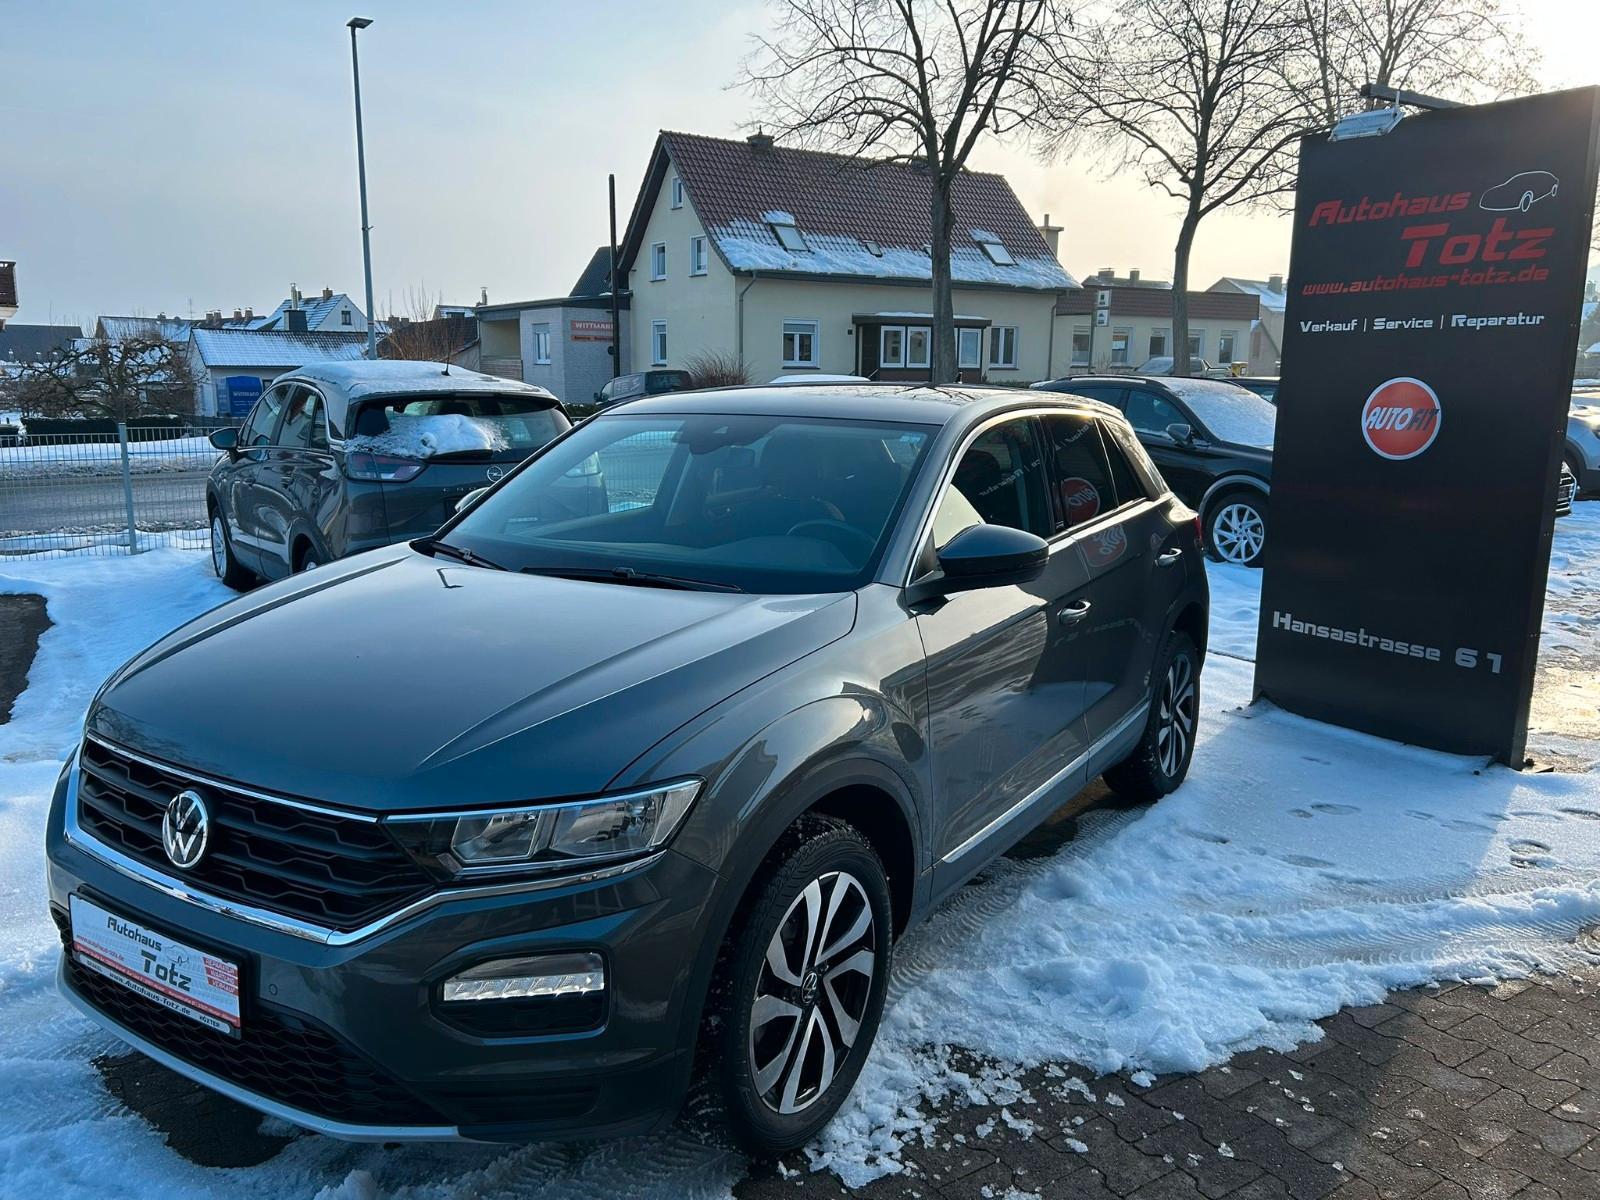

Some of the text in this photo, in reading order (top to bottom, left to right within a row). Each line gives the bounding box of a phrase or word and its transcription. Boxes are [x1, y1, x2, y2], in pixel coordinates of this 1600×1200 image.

[1309, 191, 1471, 227] Autohaus
[1401, 217, 1555, 268] Totz
[1302, 264, 1549, 296] www.autohaus-totz.de
[1300, 313, 1545, 333] Verkauf Service Reparatur
[1366, 406, 1440, 431] AUTOFIT
[1272, 611, 1440, 661] Hansastrasse
[107, 916, 162, 952] Autohaus
[141, 950, 191, 992] Totz
